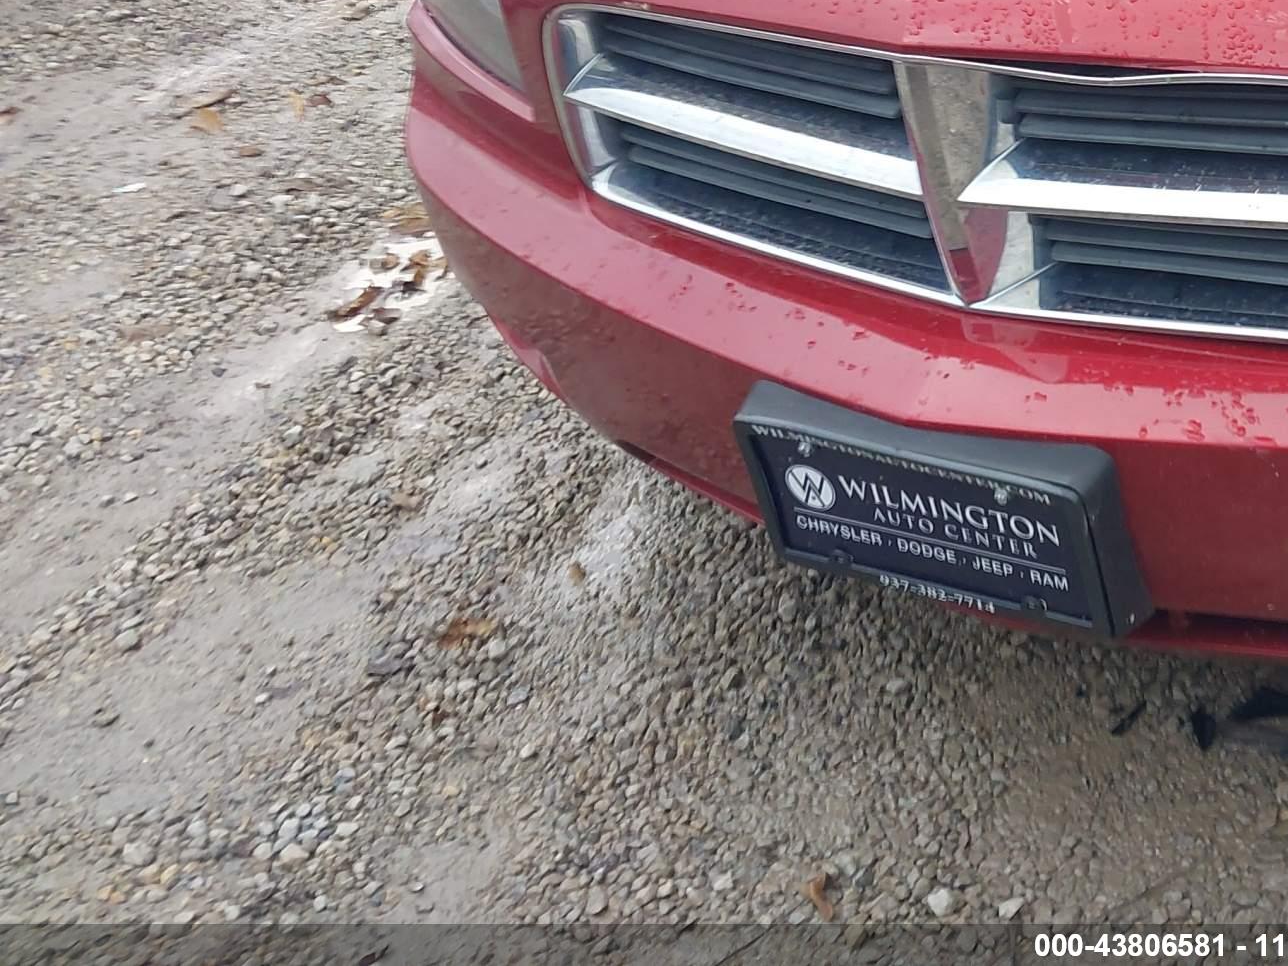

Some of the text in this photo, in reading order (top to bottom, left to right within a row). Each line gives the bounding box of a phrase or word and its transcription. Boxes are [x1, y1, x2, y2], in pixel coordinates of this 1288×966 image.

[752, 424, 1050, 505] WILMINGTONAUTOCENTERCOM
[838, 475, 1060, 547] WILMINGTON
[873, 507, 1038, 559] AUTO CENTER
[796, 515, 1069, 592] CHRYSLER DODGE JEEP RAM
